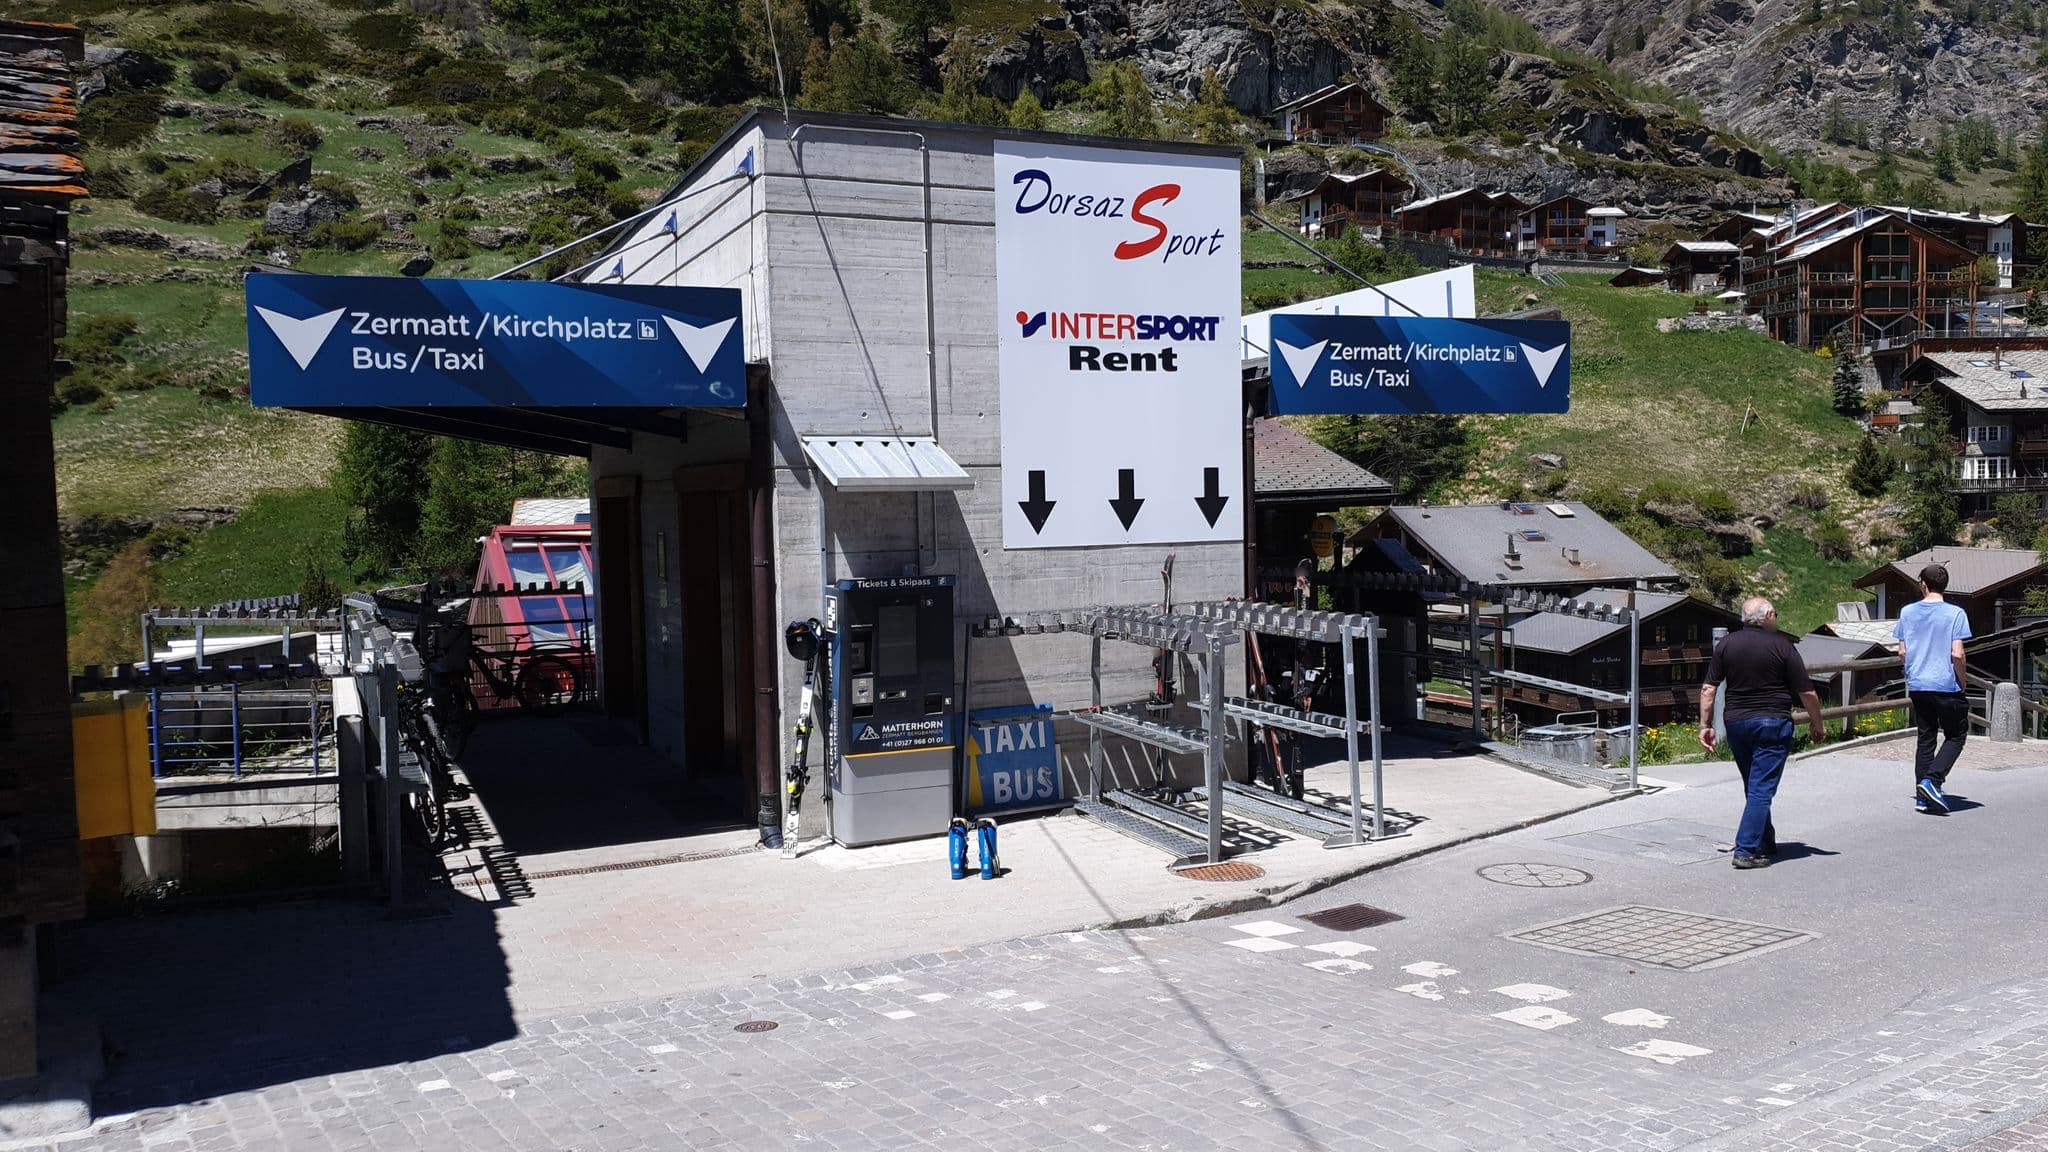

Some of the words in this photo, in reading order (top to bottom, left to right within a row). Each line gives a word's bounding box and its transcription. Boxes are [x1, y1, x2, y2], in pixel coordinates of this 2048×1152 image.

[1013, 169, 1124, 218] Dorsaz
[1113, 183, 1225, 264] Sport
[1051, 312, 1220, 342] INTERSPORT
[1068, 345, 1178, 372] Rent
[856, 580, 889, 589] Tickets
[890, 579, 897, 587] &
[898, 578, 932, 588] Skipass
[881, 720, 943, 733] MATTERHORN
[978, 721, 1046, 754] TAXI
[993, 766, 1054, 804] BUS
